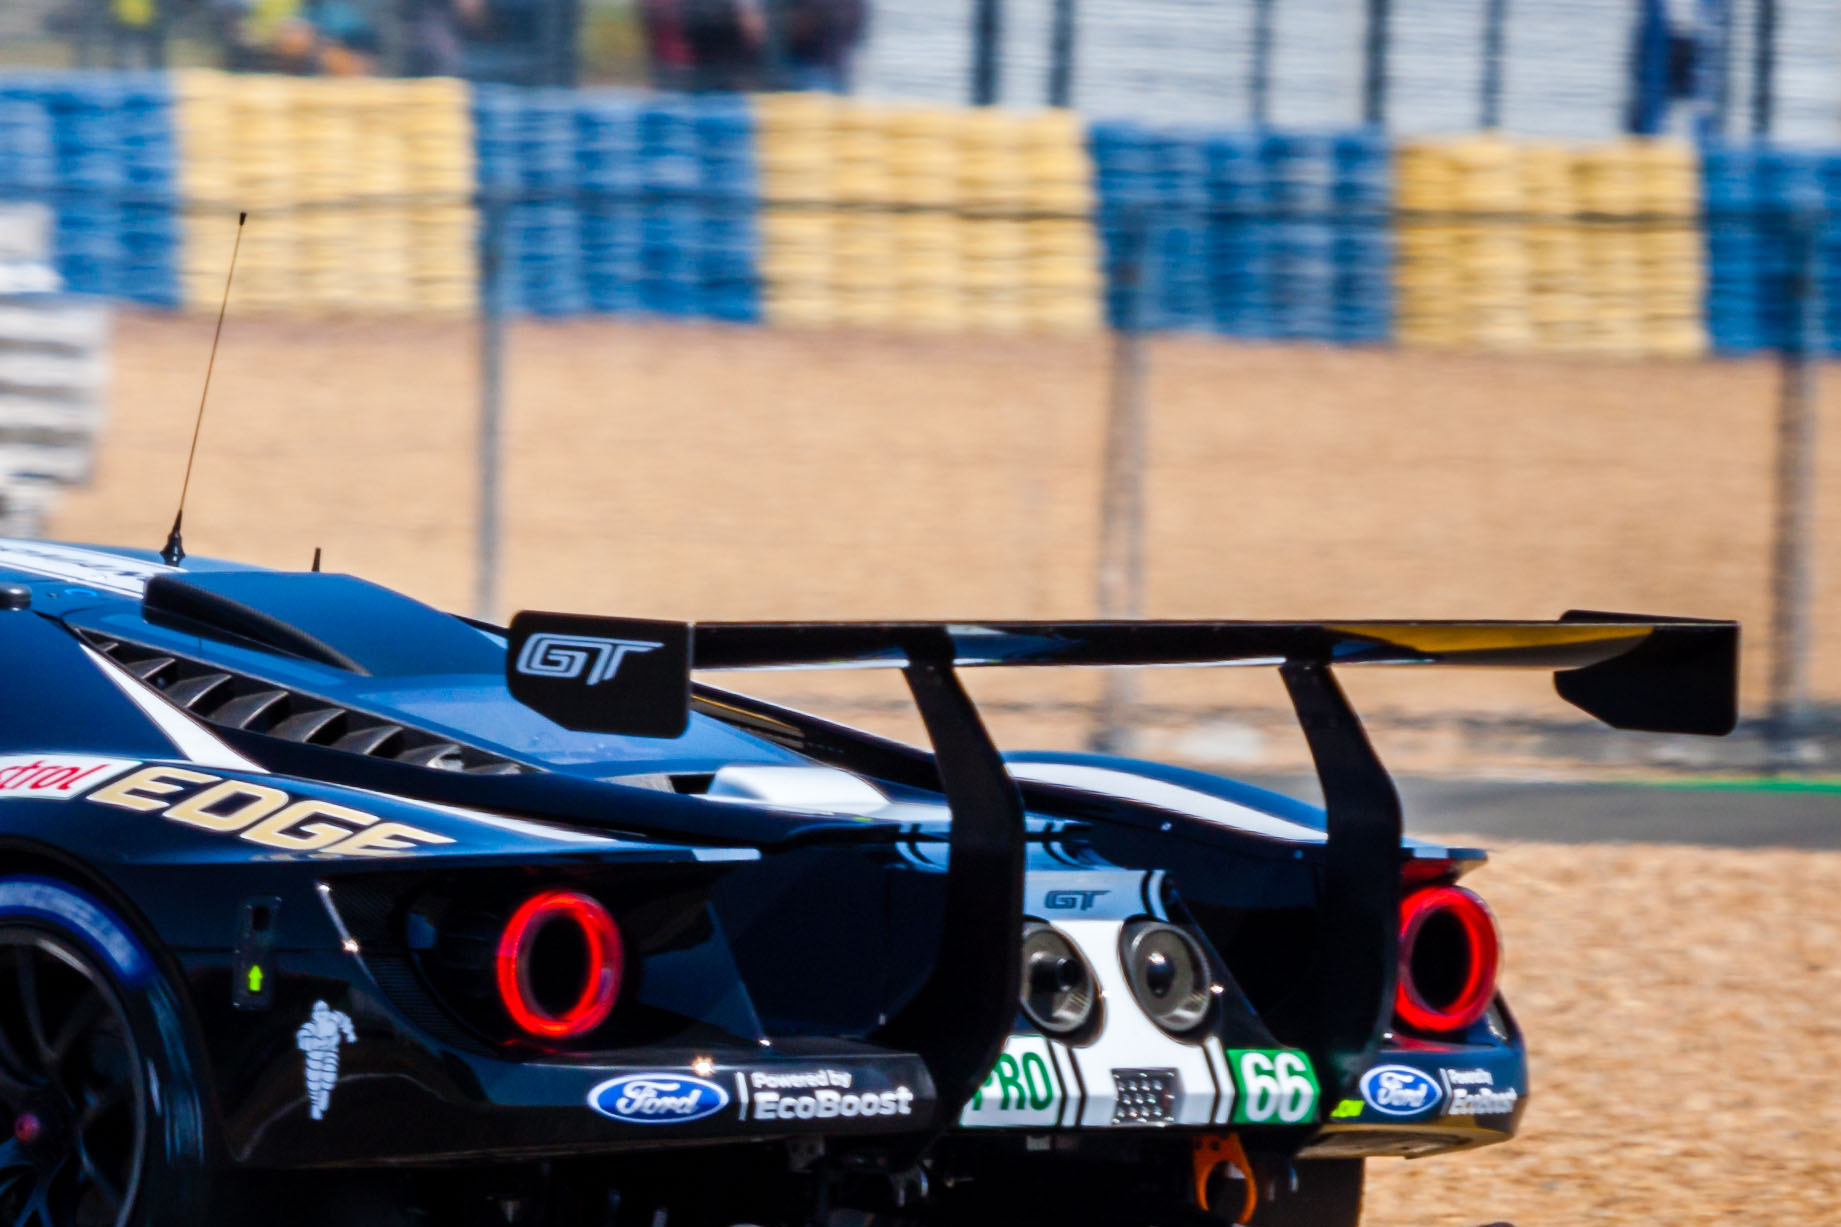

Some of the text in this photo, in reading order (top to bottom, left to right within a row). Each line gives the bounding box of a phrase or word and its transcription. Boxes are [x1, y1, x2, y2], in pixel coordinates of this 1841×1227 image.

[516, 632, 665, 686] GT
[85, 765, 458, 858] EDGE
[1043, 889, 1111, 912] GT
[615, 1079, 703, 1115] Ford
[751, 1069, 853, 1089] Powered by
[1239, 1052, 1313, 1123] 66
[1376, 1071, 1429, 1108] Ford
[752, 1085, 914, 1120] EcoBoost
